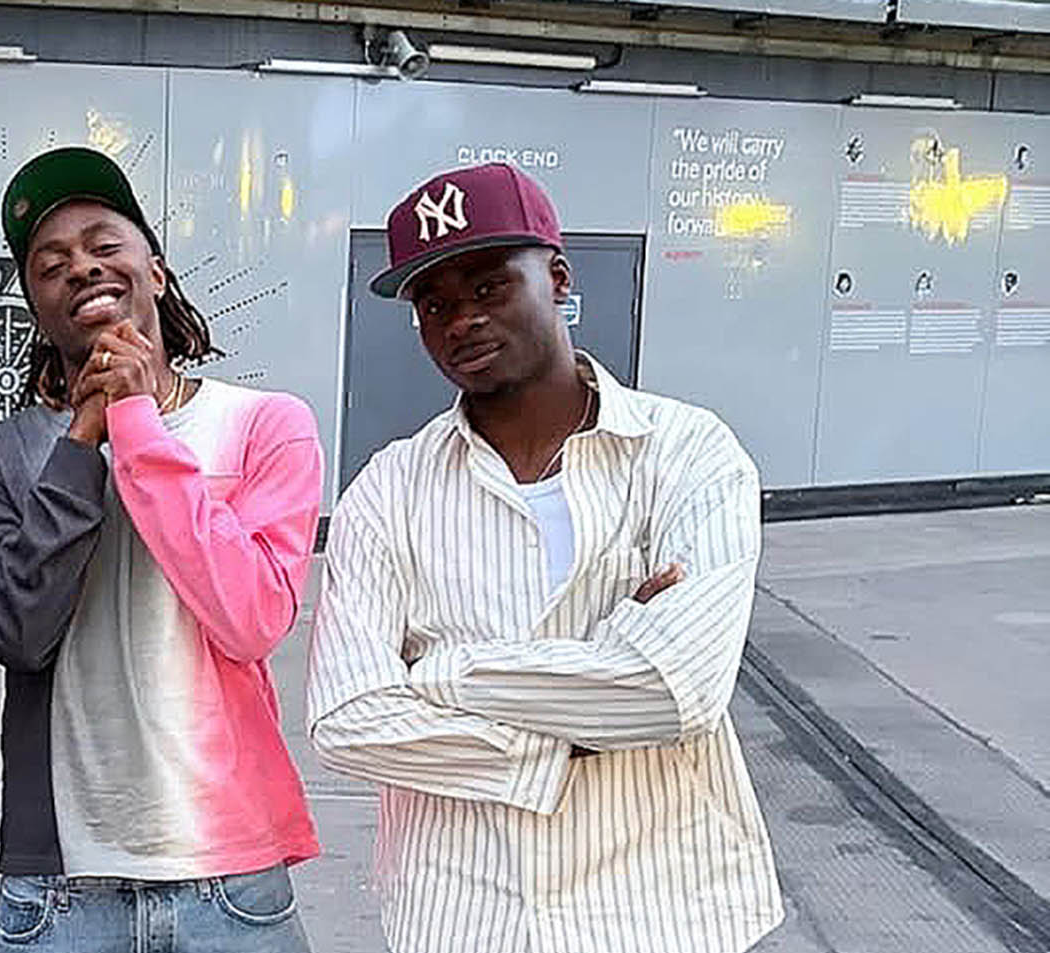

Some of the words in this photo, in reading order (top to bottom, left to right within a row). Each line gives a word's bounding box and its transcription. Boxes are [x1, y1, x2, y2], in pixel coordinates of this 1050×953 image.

[458, 148, 518, 165] CLOCK
[522, 151, 559, 167] END
[711, 132, 739, 155] will
[741, 138, 786, 160] carry
[672, 158, 701, 179] the
[703, 159, 746, 185] pride
[748, 159, 768, 181] of
[669, 190, 700, 207] our
